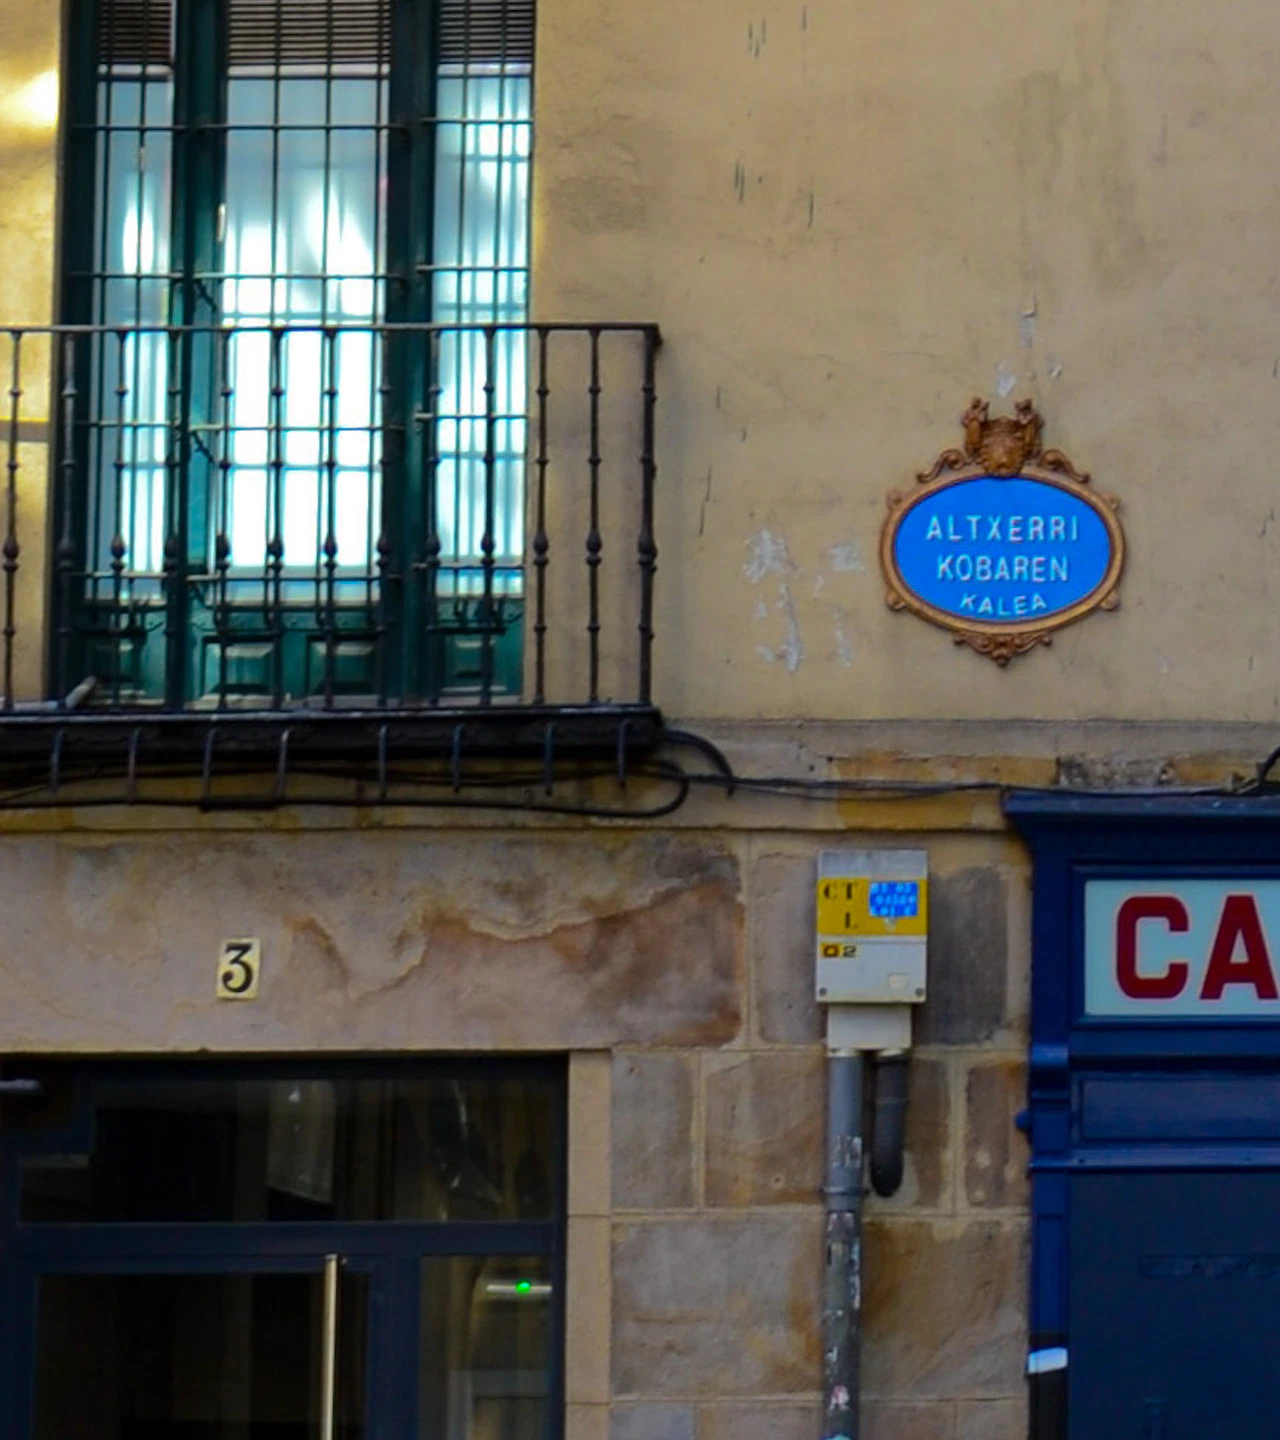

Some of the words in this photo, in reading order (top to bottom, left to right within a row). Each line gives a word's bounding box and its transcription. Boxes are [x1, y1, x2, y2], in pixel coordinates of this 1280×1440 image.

[926, 515, 1078, 541] ALTXERRI
[937, 554, 1068, 582] KOBAREN
[959, 593, 1048, 615] KALEA
[221, 942, 254, 994] 3
